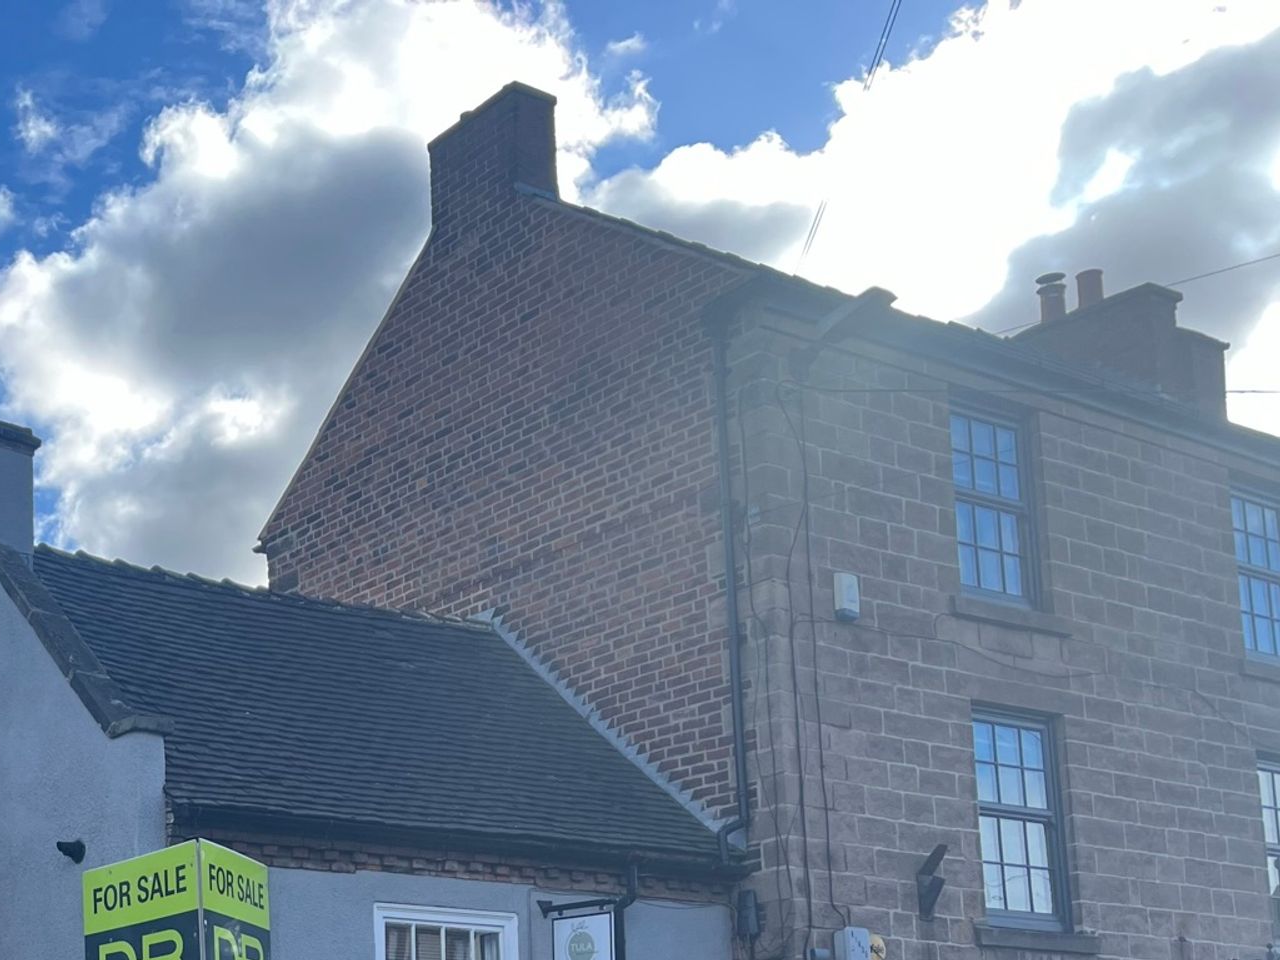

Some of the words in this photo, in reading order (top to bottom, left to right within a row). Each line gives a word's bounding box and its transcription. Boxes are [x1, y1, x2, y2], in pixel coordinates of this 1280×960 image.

[93, 881, 131, 914] FOR
[137, 865, 188, 903] SALE
[209, 863, 234, 898] FOR
[237, 874, 264, 910] SALE
